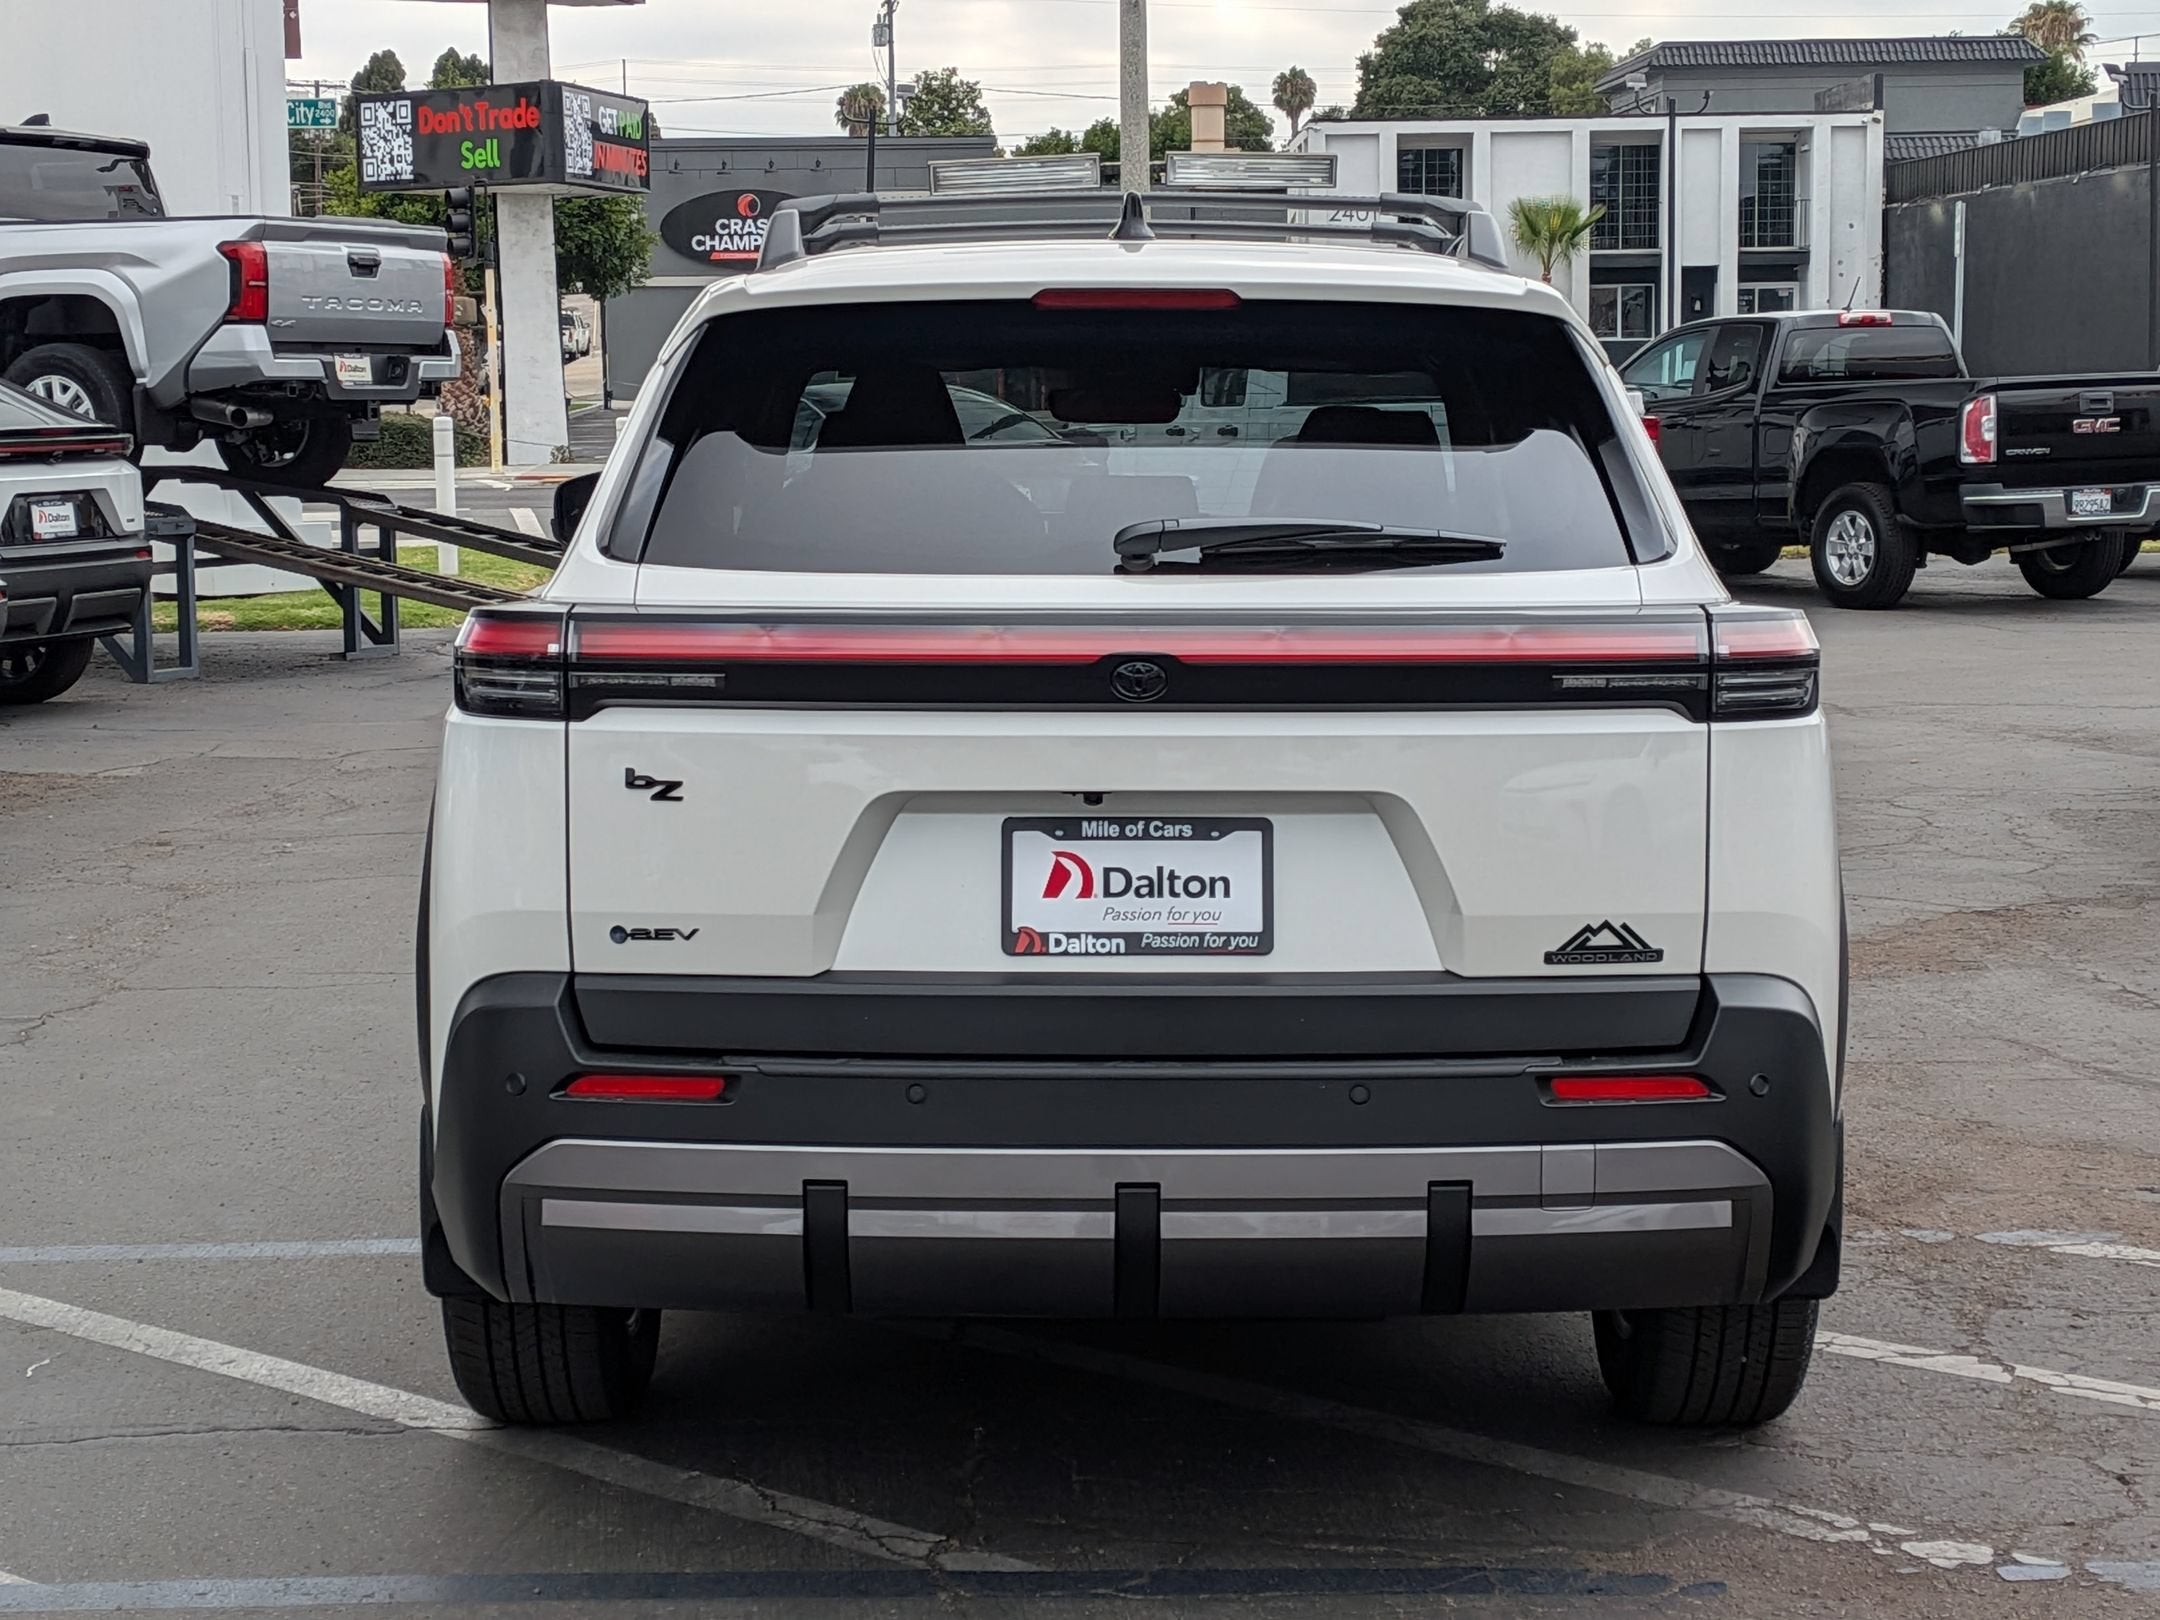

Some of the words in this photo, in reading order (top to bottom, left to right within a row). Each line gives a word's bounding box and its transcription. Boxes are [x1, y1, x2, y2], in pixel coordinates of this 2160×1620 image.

[287, 101, 314, 126] City
[418, 103, 473, 136] Don't
[474, 97, 541, 131] Trade
[599, 105, 618, 136] GET
[618, 111, 643, 140] PAID
[460, 137, 500, 170] Sell
[715, 218, 769, 235] CRAS
[691, 234, 762, 251] CHAMP
[301, 296, 424, 313] TACOMA
[2073, 417, 2121, 434] GMC
[1081, 820, 1120, 837] Mile
[1125, 820, 1146, 837] of
[1149, 820, 1193, 838] Cars
[1102, 866, 1231, 899] Dalton
[1102, 907, 1161, 922] Passion
[1166, 906, 1190, 923] for
[1191, 910, 1222, 923] you
[1048, 932, 1126, 954] Dalton
[1141, 932, 1199, 948] Passion
[1202, 932, 1225, 949] for
[1228, 935, 1259, 952] you
[1551, 952, 1658, 963] WOODLAND
